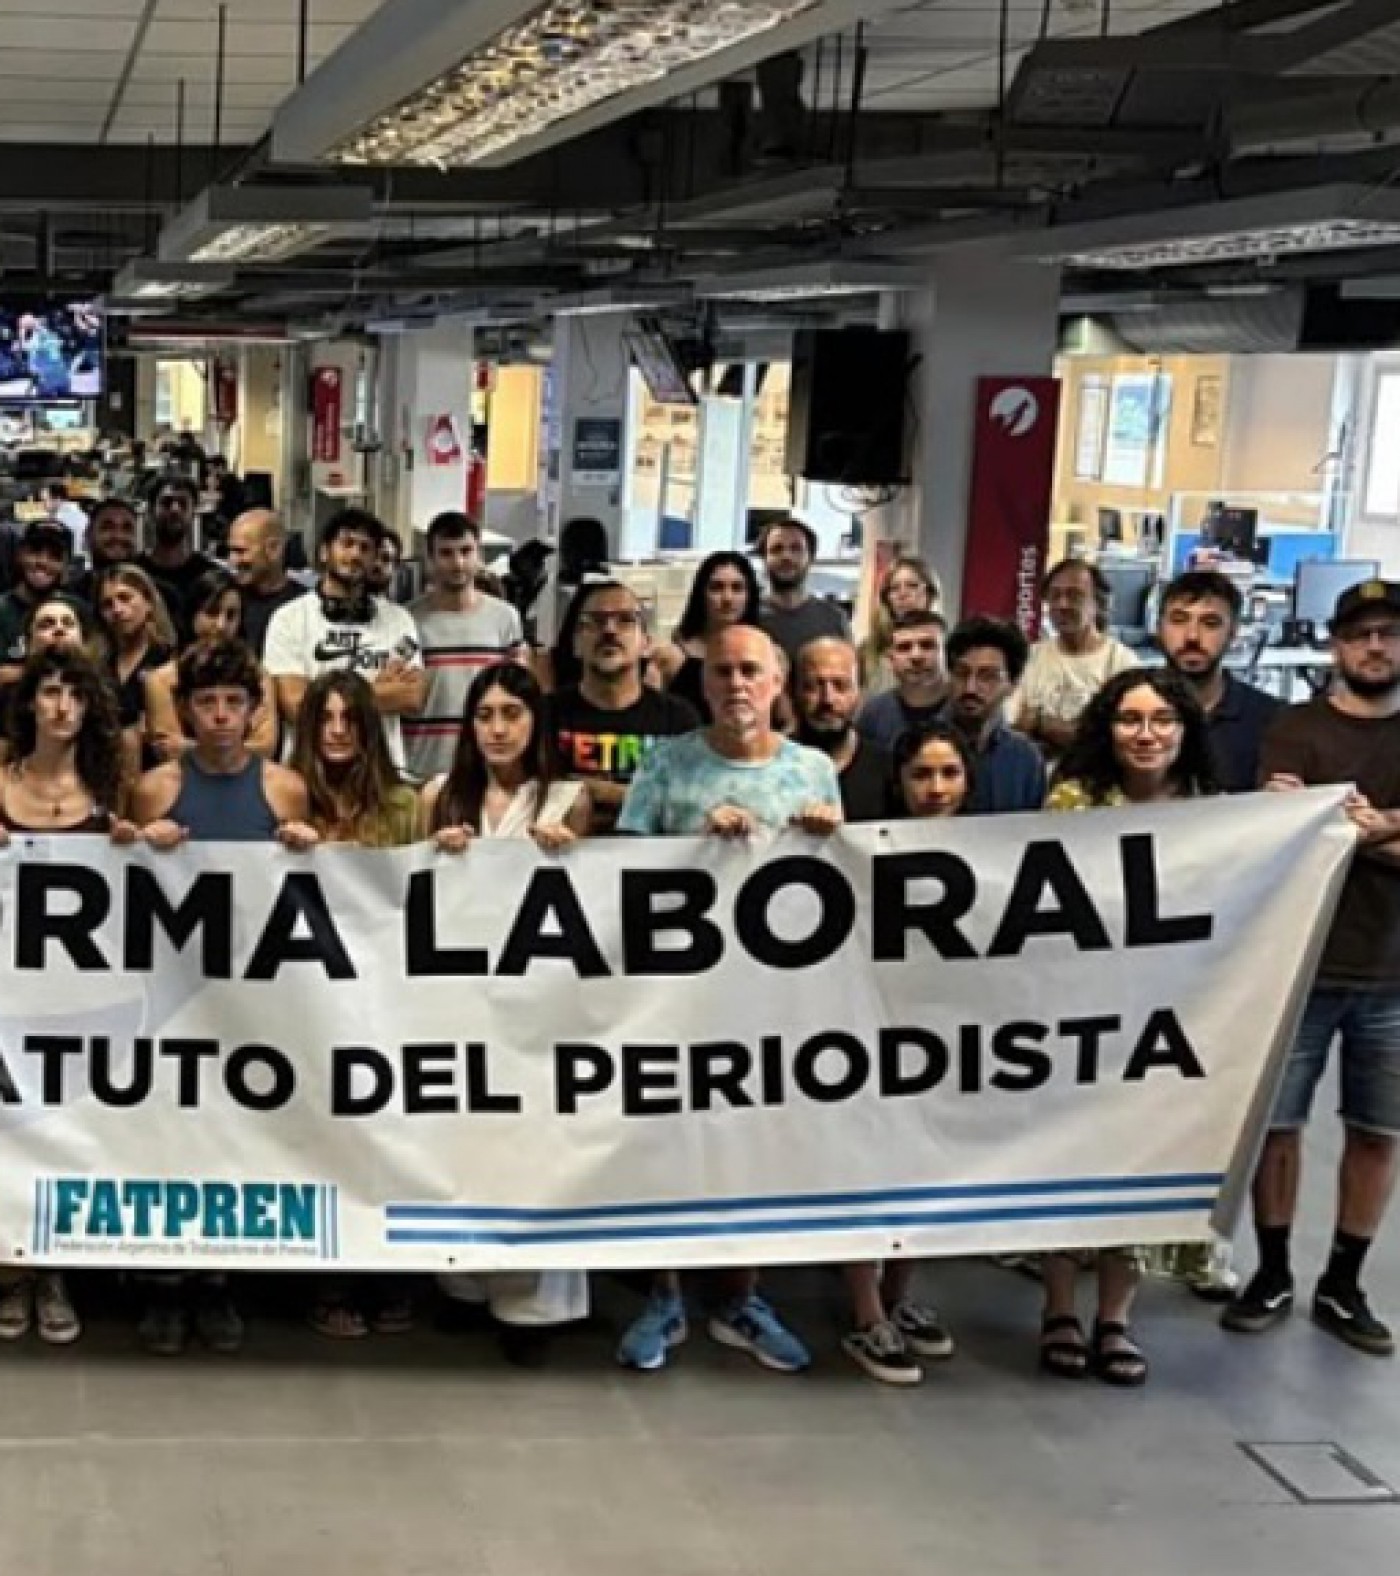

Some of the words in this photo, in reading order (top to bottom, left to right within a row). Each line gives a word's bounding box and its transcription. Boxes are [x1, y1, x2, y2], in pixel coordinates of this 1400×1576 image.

[1016, 545, 1037, 631] eportes
[558, 730, 655, 771] ETR
[404, 833, 1213, 979] LABORAL
[331, 1043, 521, 1116] DEL
[555, 1008, 1206, 1116] PERIODISTA
[55, 1178, 316, 1239] FATPREN
